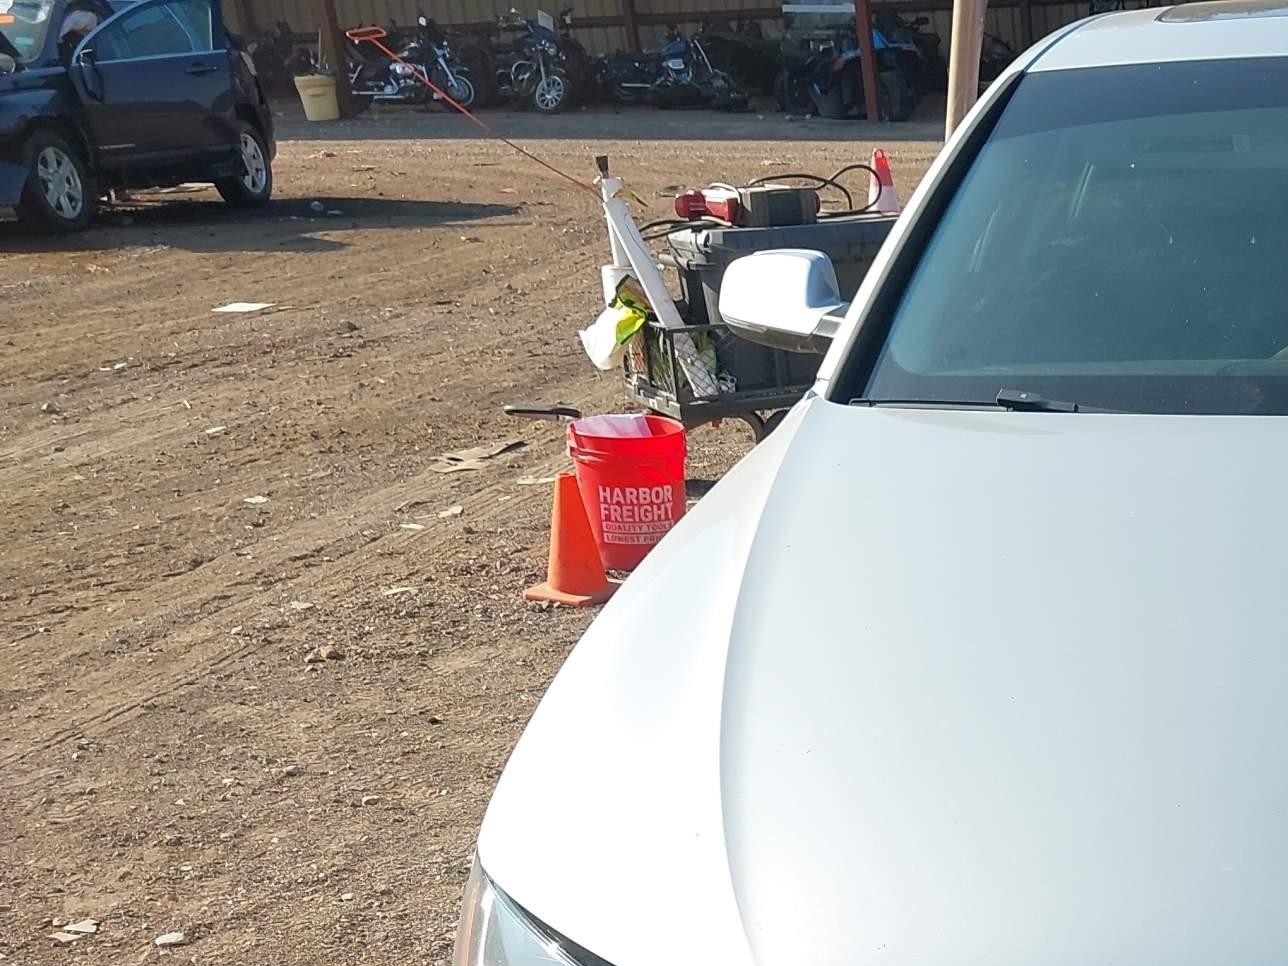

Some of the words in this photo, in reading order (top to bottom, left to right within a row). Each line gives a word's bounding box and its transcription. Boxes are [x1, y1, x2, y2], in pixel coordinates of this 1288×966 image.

[598, 485, 673, 505] HARBOR
[600, 503, 673, 523] FREIGHT
[605, 523, 643, 532] QUALITY
